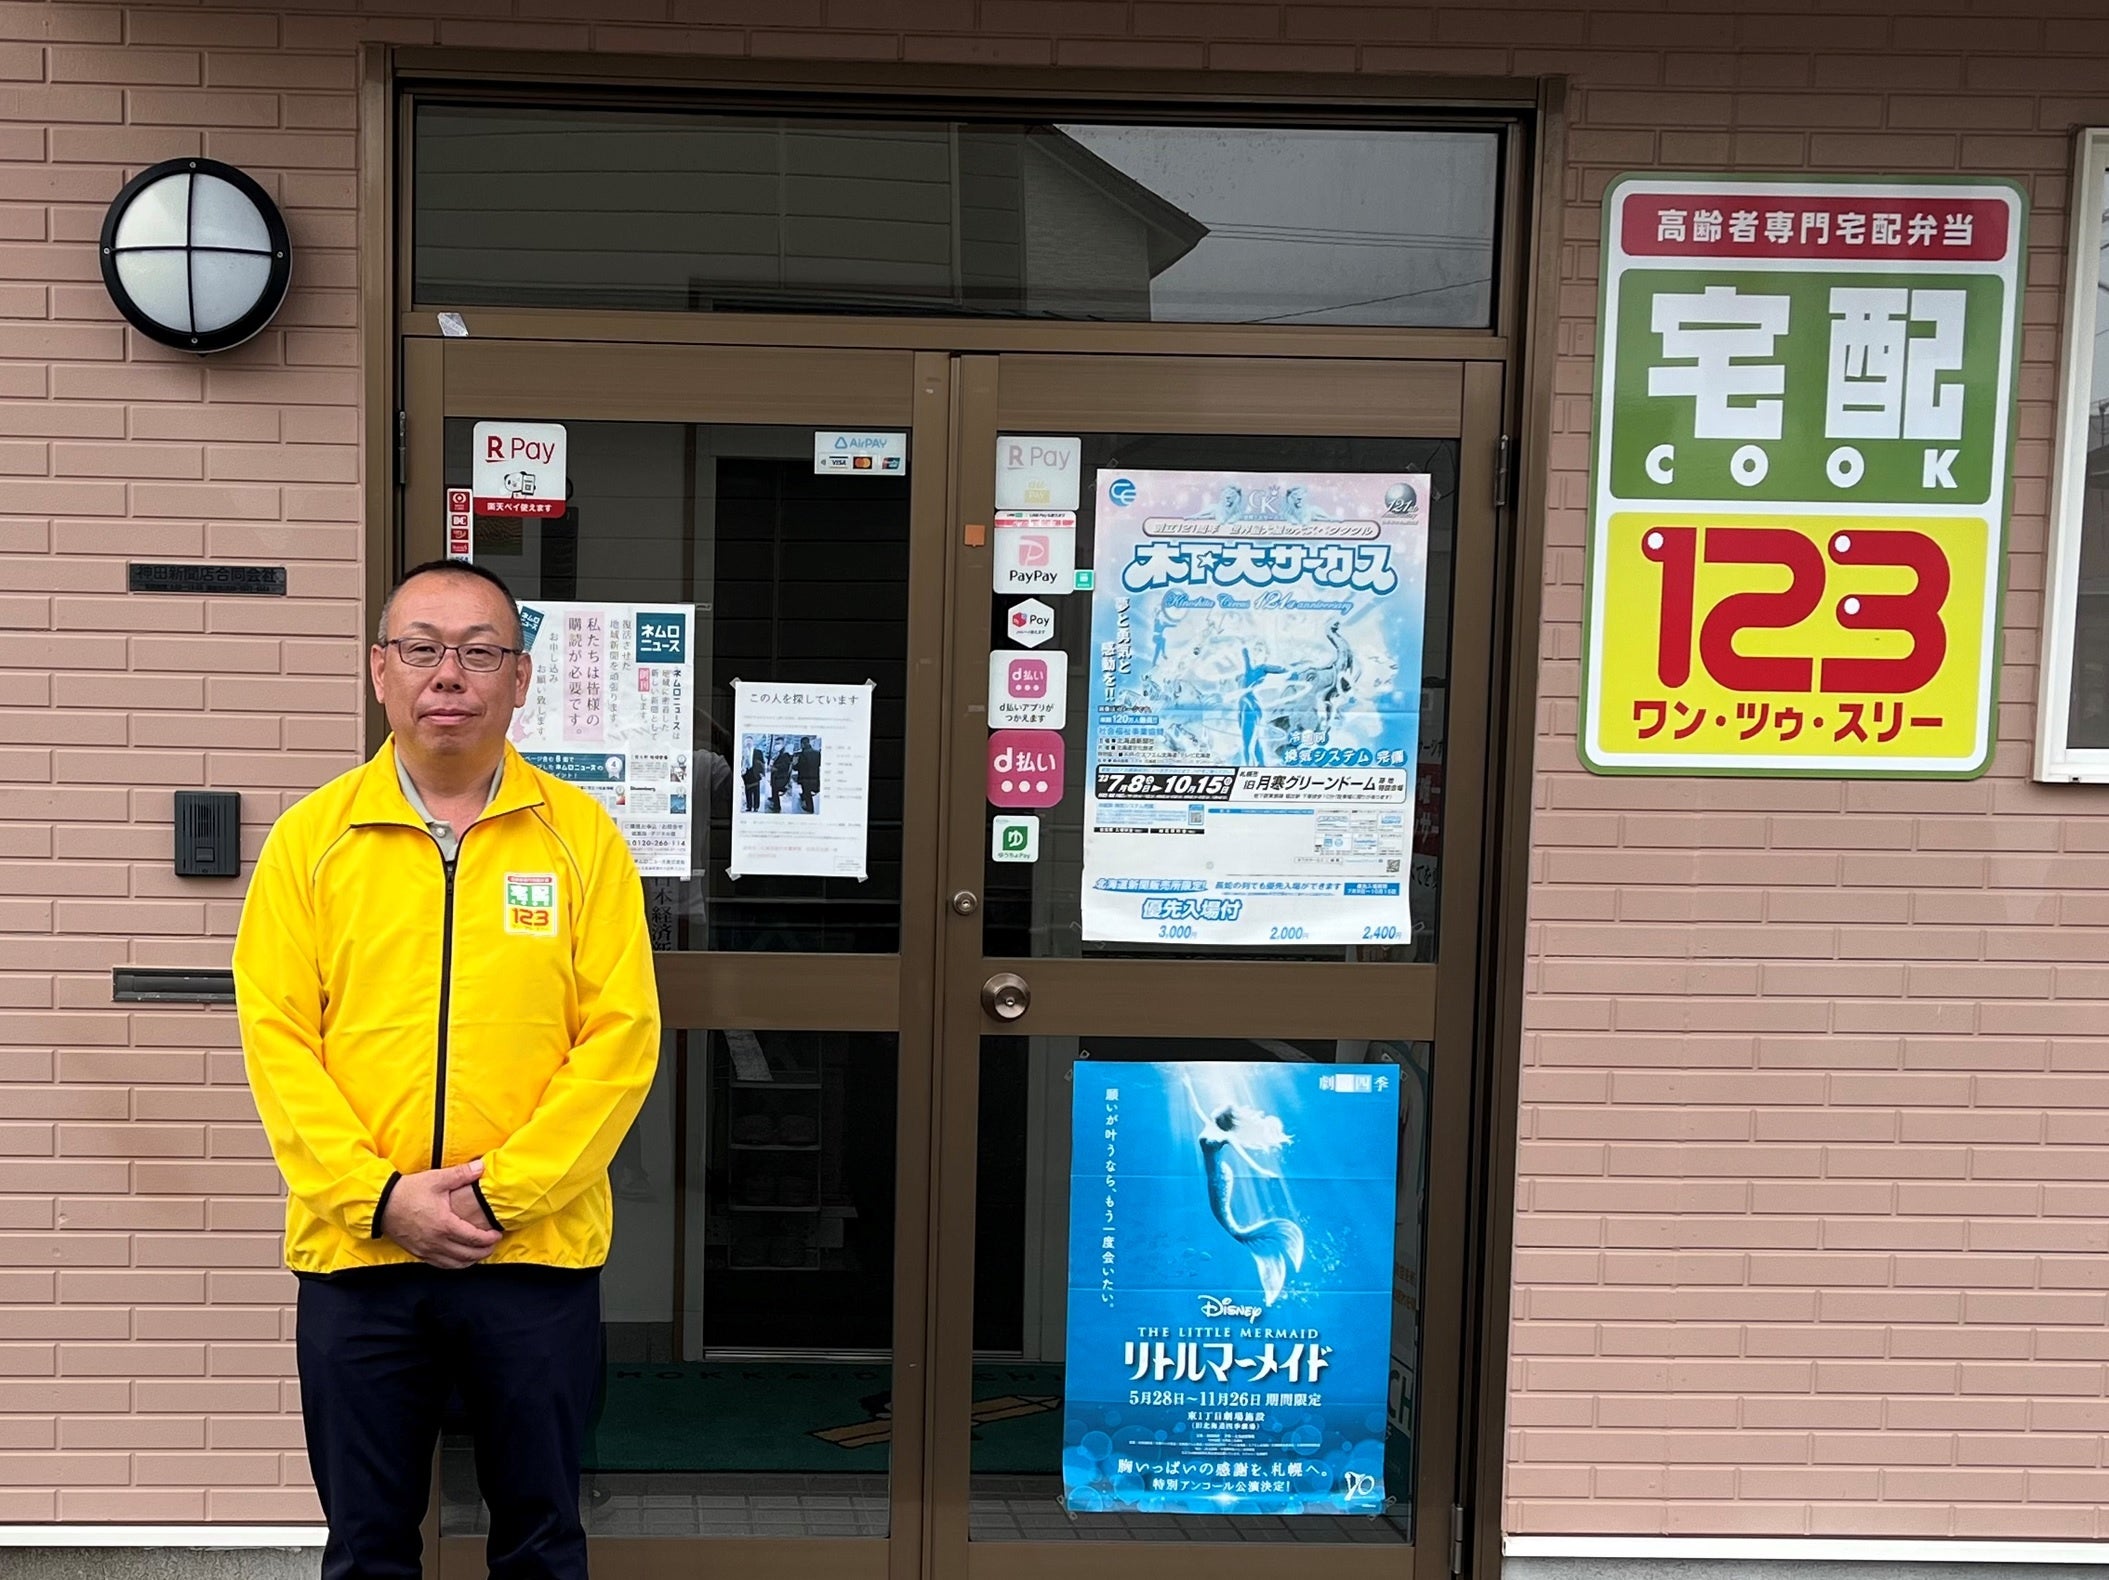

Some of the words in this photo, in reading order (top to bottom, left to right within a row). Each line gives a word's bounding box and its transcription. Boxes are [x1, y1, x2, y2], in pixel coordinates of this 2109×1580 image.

[1657, 209, 1975, 247] 高齢者専門宅配弁当
[1648, 286, 1967, 440] 宅配
[485, 436, 508, 463] R
[511, 437, 556, 464] Pay
[1007, 445, 1025, 470] R
[1030, 446, 1071, 471] Pay
[1645, 444, 1960, 488] COOK
[1009, 569, 1058, 584] PayPay
[1029, 614, 1050, 627] Pay
[1641, 526, 1951, 694] 123
[640, 624, 680, 639] ネムロ
[640, 640, 680, 652] ニュース
[549, 632, 560, 683] お申し込み
[568, 617, 583, 735] 購読が必要です。
[586, 617, 601, 726] 私たちは皆様の
[1012, 667, 1044, 681] d払い
[672, 668, 682, 740] ネムロニュースは
[750, 693, 859, 706] この人を探しています
[999, 703, 1054, 713] d払いアプリが
[1005, 714, 1046, 723] つかえます
[1632, 700, 1944, 744] ワン・ツゥ・スリー
[993, 747, 1056, 773] d払い
[511, 907, 549, 926] 123
[1142, 897, 1242, 921] 優先入場付
[1319, 1073, 1389, 1093] 劇四季
[1101, 1088, 1120, 1308] 願いが叶うなら、もう一度会いたい。
[1138, 1327, 1170, 1338] THE
[1179, 1327, 1231, 1338] LITTLE
[1240, 1328, 1319, 1339] MERMAID
[1124, 1341, 1333, 1383] リトルマーメイド
[1265, 1392, 1322, 1407] 期間限定
[1187, 1411, 1266, 1422] 東1丁目劇場施設
[1117, 1459, 1328, 1478] 胸いっぱいの感謝を、札幌へ。
[1152, 1478, 1291, 1493] 特別アンコール公演決定!
